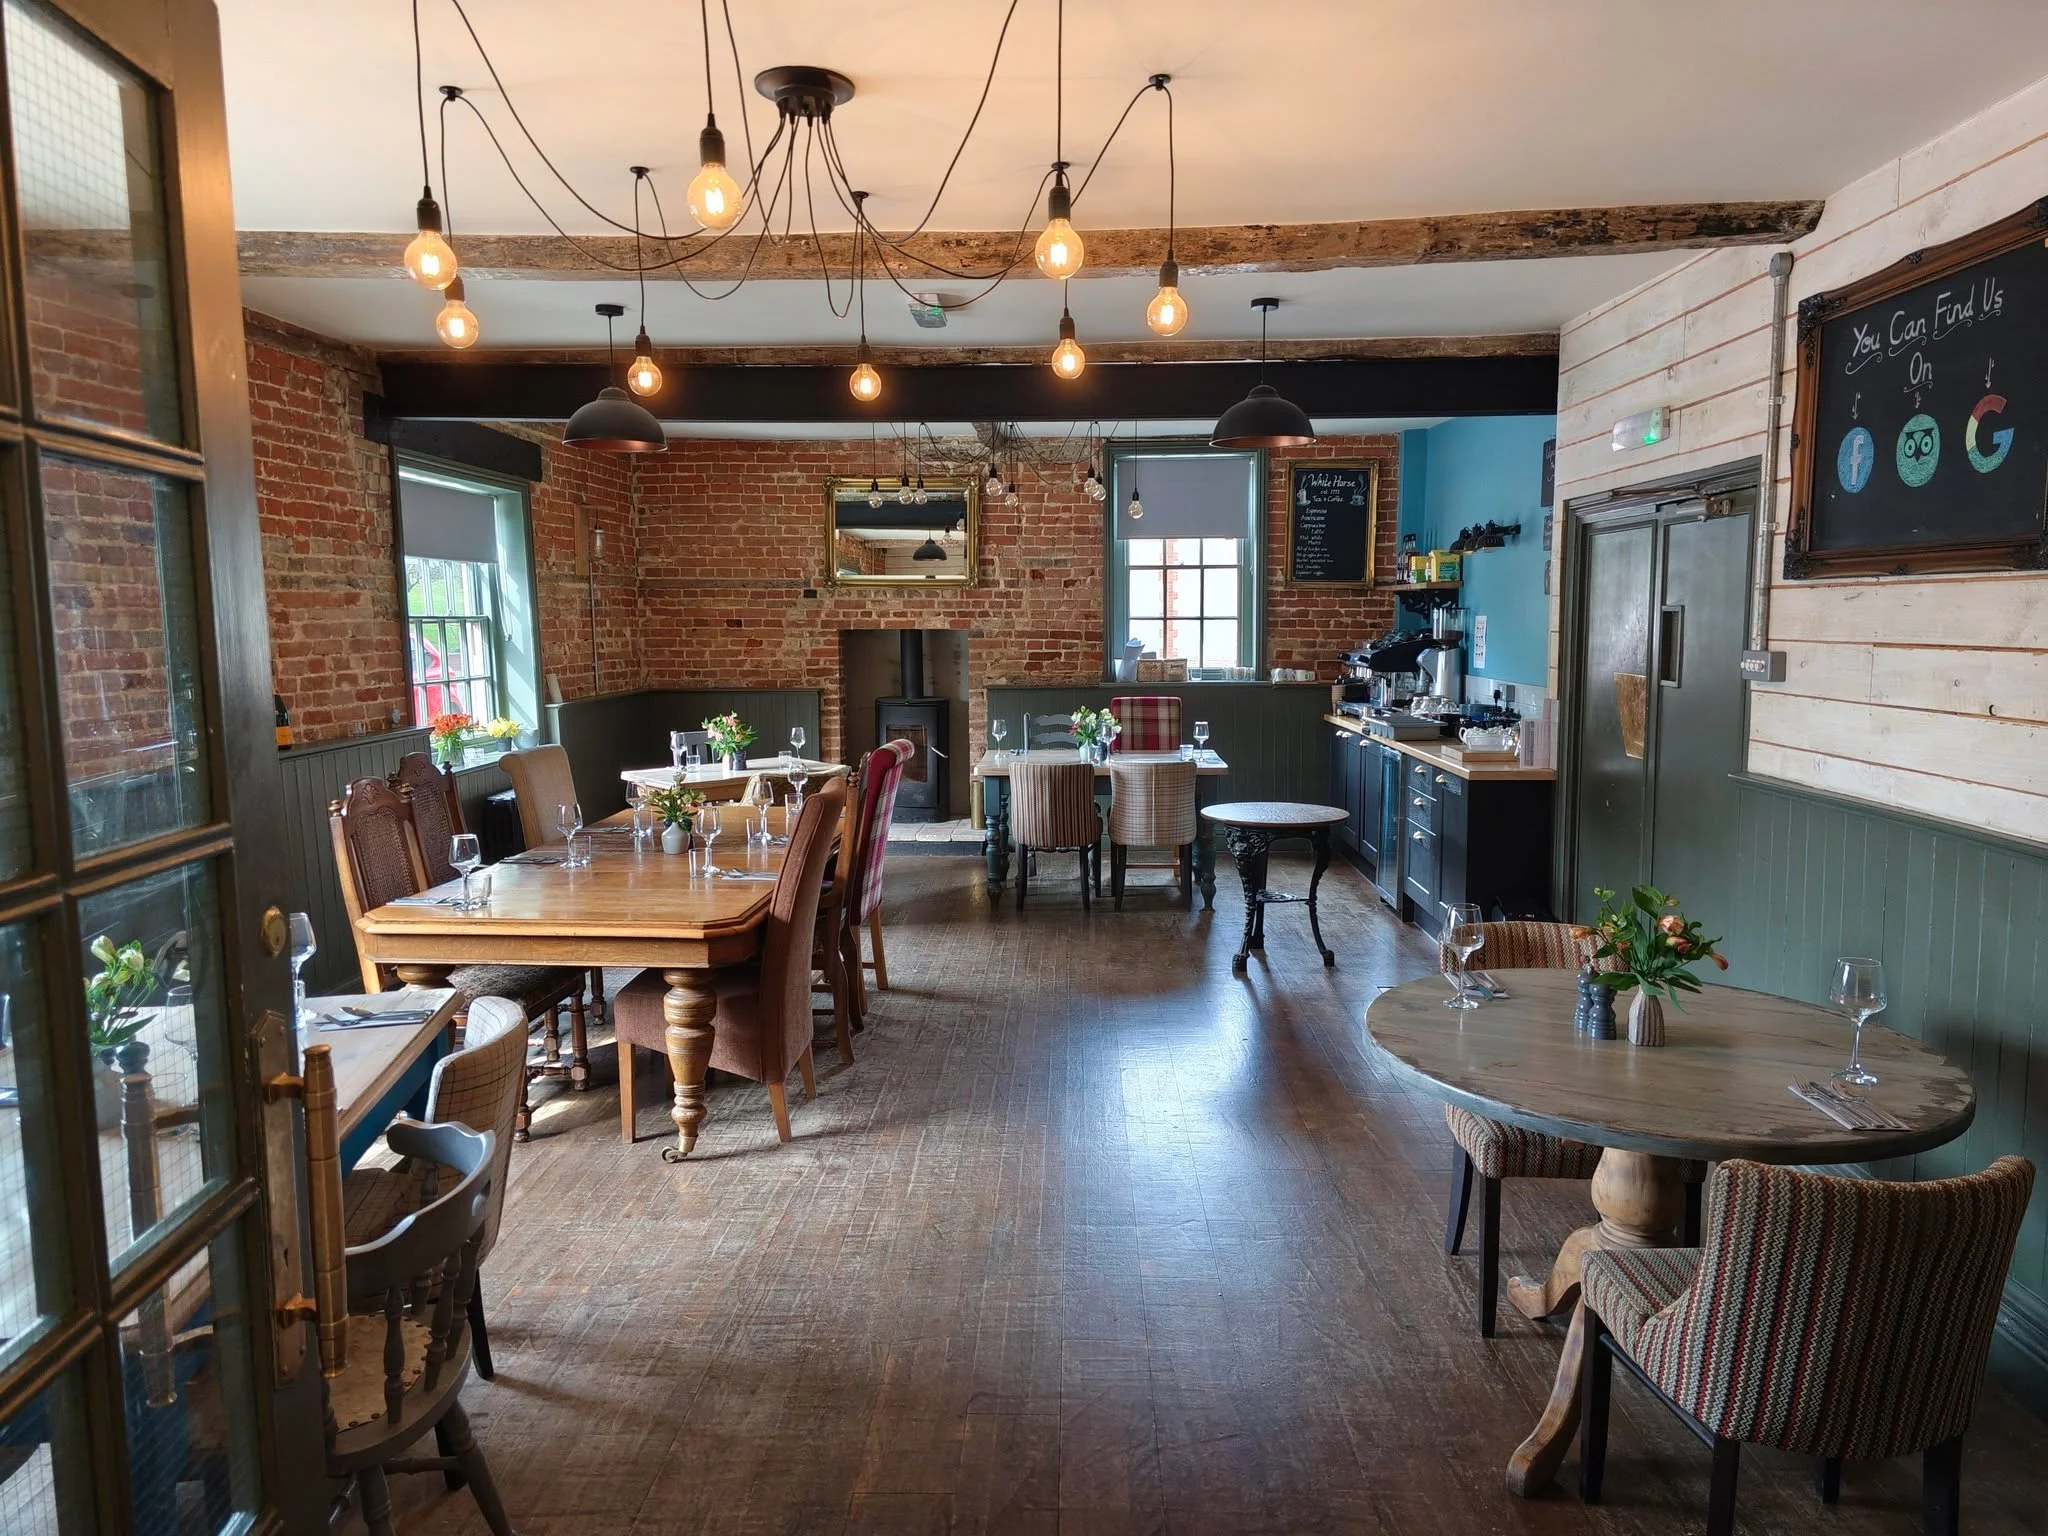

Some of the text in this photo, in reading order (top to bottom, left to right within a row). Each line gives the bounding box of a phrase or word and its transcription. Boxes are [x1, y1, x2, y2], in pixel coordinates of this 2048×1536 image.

[1852, 276, 2004, 357] You Can Find Us
[1909, 351, 1933, 384] On
[1966, 393, 2015, 474] G
[1307, 473, 1356, 487] White Horse
[1305, 507, 1328, 515] Espresso
